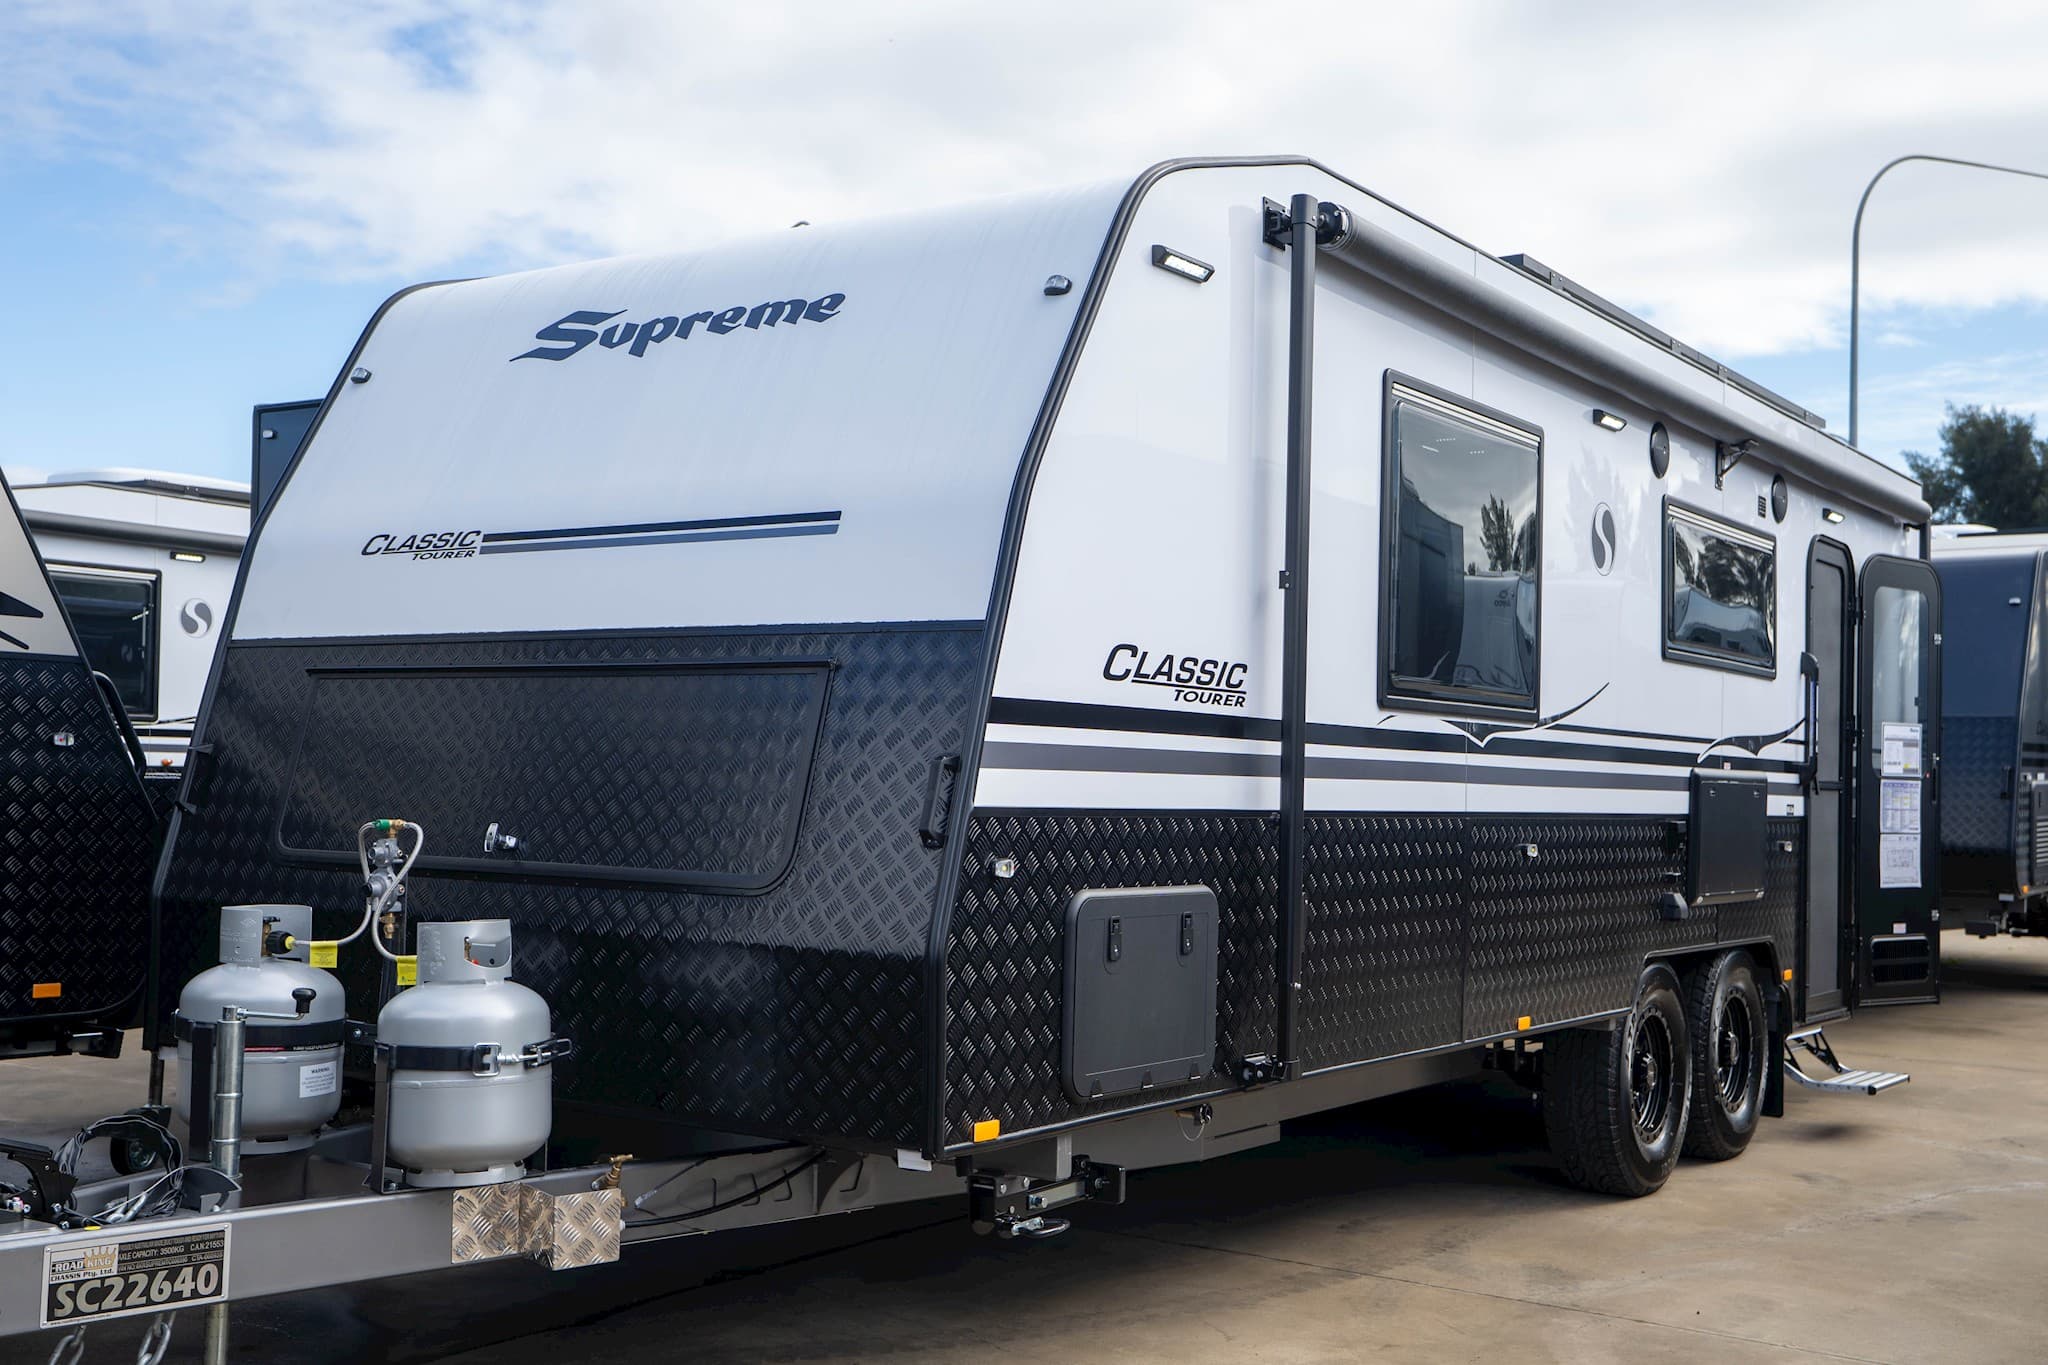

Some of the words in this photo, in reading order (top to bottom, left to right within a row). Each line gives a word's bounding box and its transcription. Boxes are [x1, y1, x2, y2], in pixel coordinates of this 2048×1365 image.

[509, 293, 846, 362] Supreme
[361, 530, 482, 556] CLASSIC
[412, 549, 476, 561] TOURER
[1102, 643, 1249, 689] CLASSIC
[1174, 688, 1247, 708] TOURER
[55, 1260, 84, 1273] ROAD
[87, 1256, 112, 1268] KING
[50, 1272, 81, 1282] CHASSIS
[54, 1262, 220, 1319] SC22640
